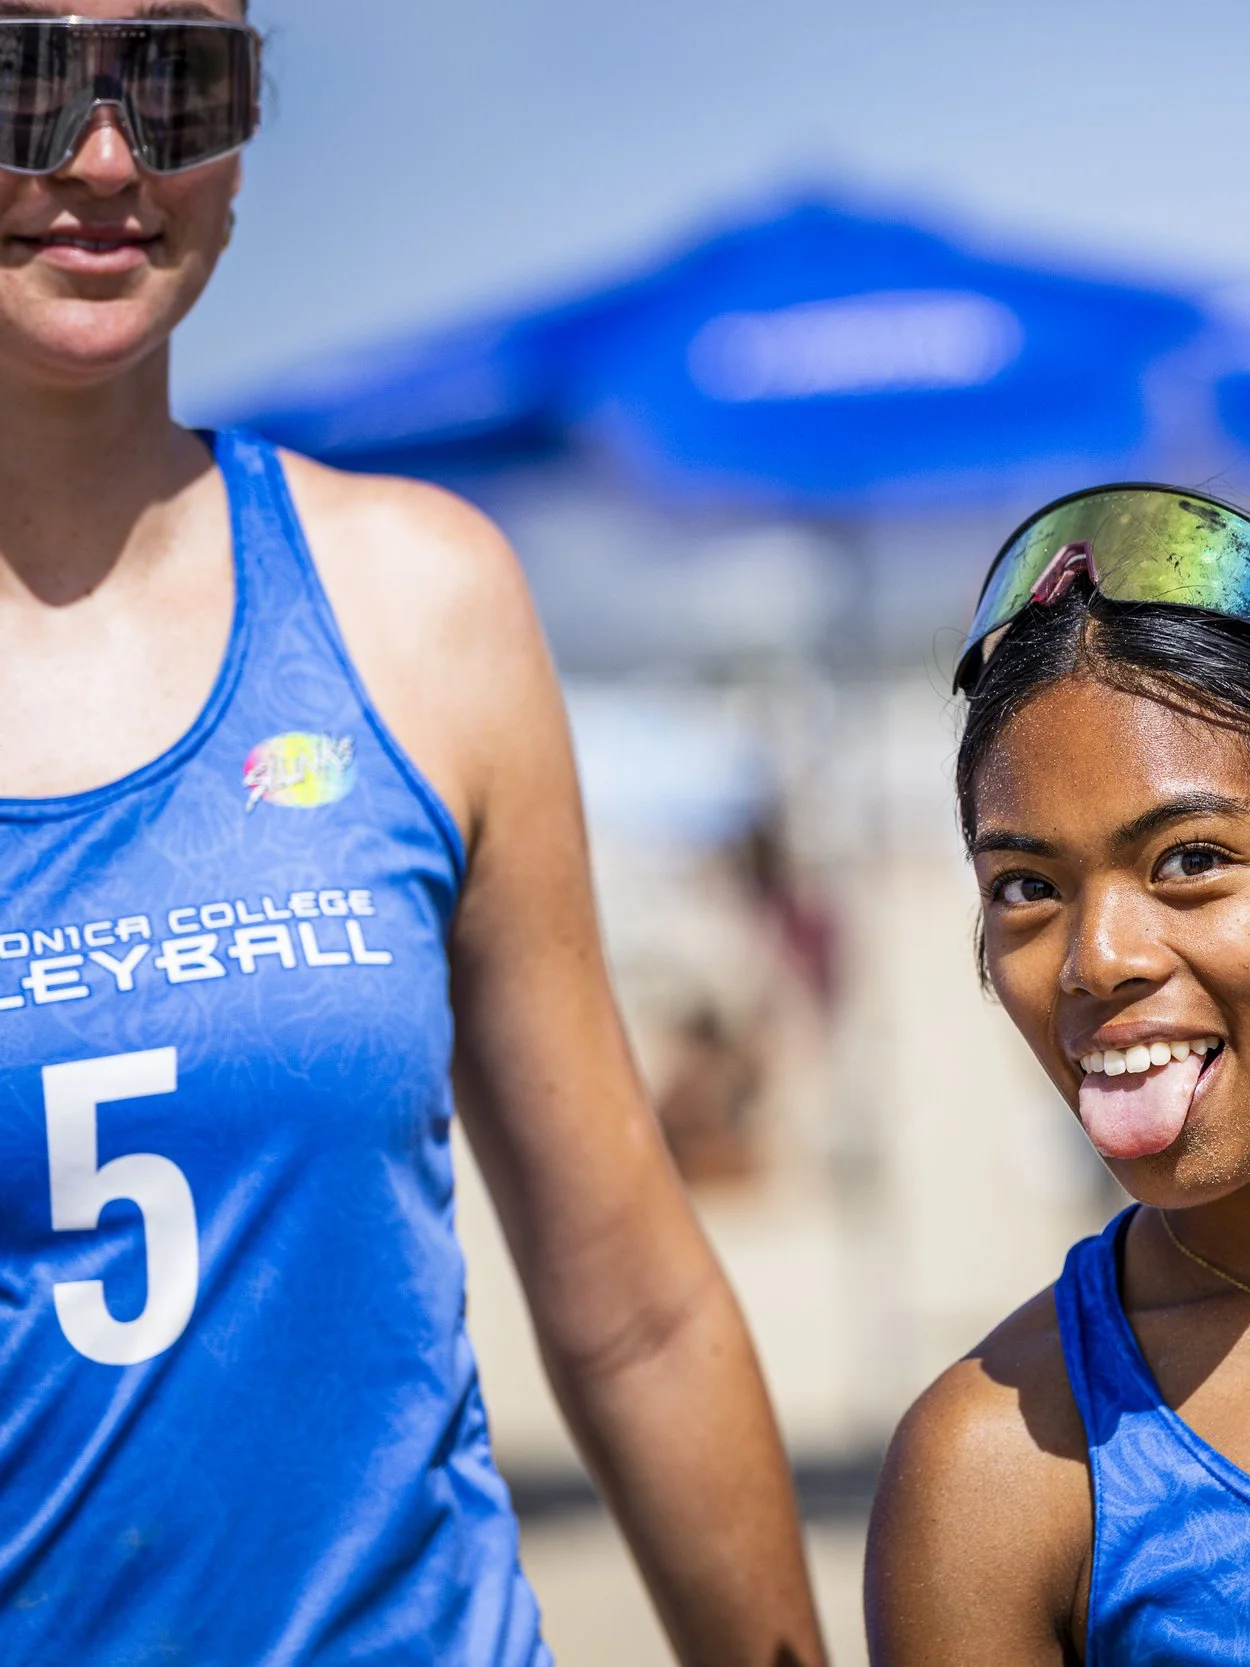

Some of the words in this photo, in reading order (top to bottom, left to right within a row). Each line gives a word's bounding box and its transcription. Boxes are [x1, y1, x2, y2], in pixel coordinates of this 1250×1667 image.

[0, 915, 151, 959] ONICA
[168, 889, 376, 935] COLLEGE
[42, 1046, 200, 1366] 5
